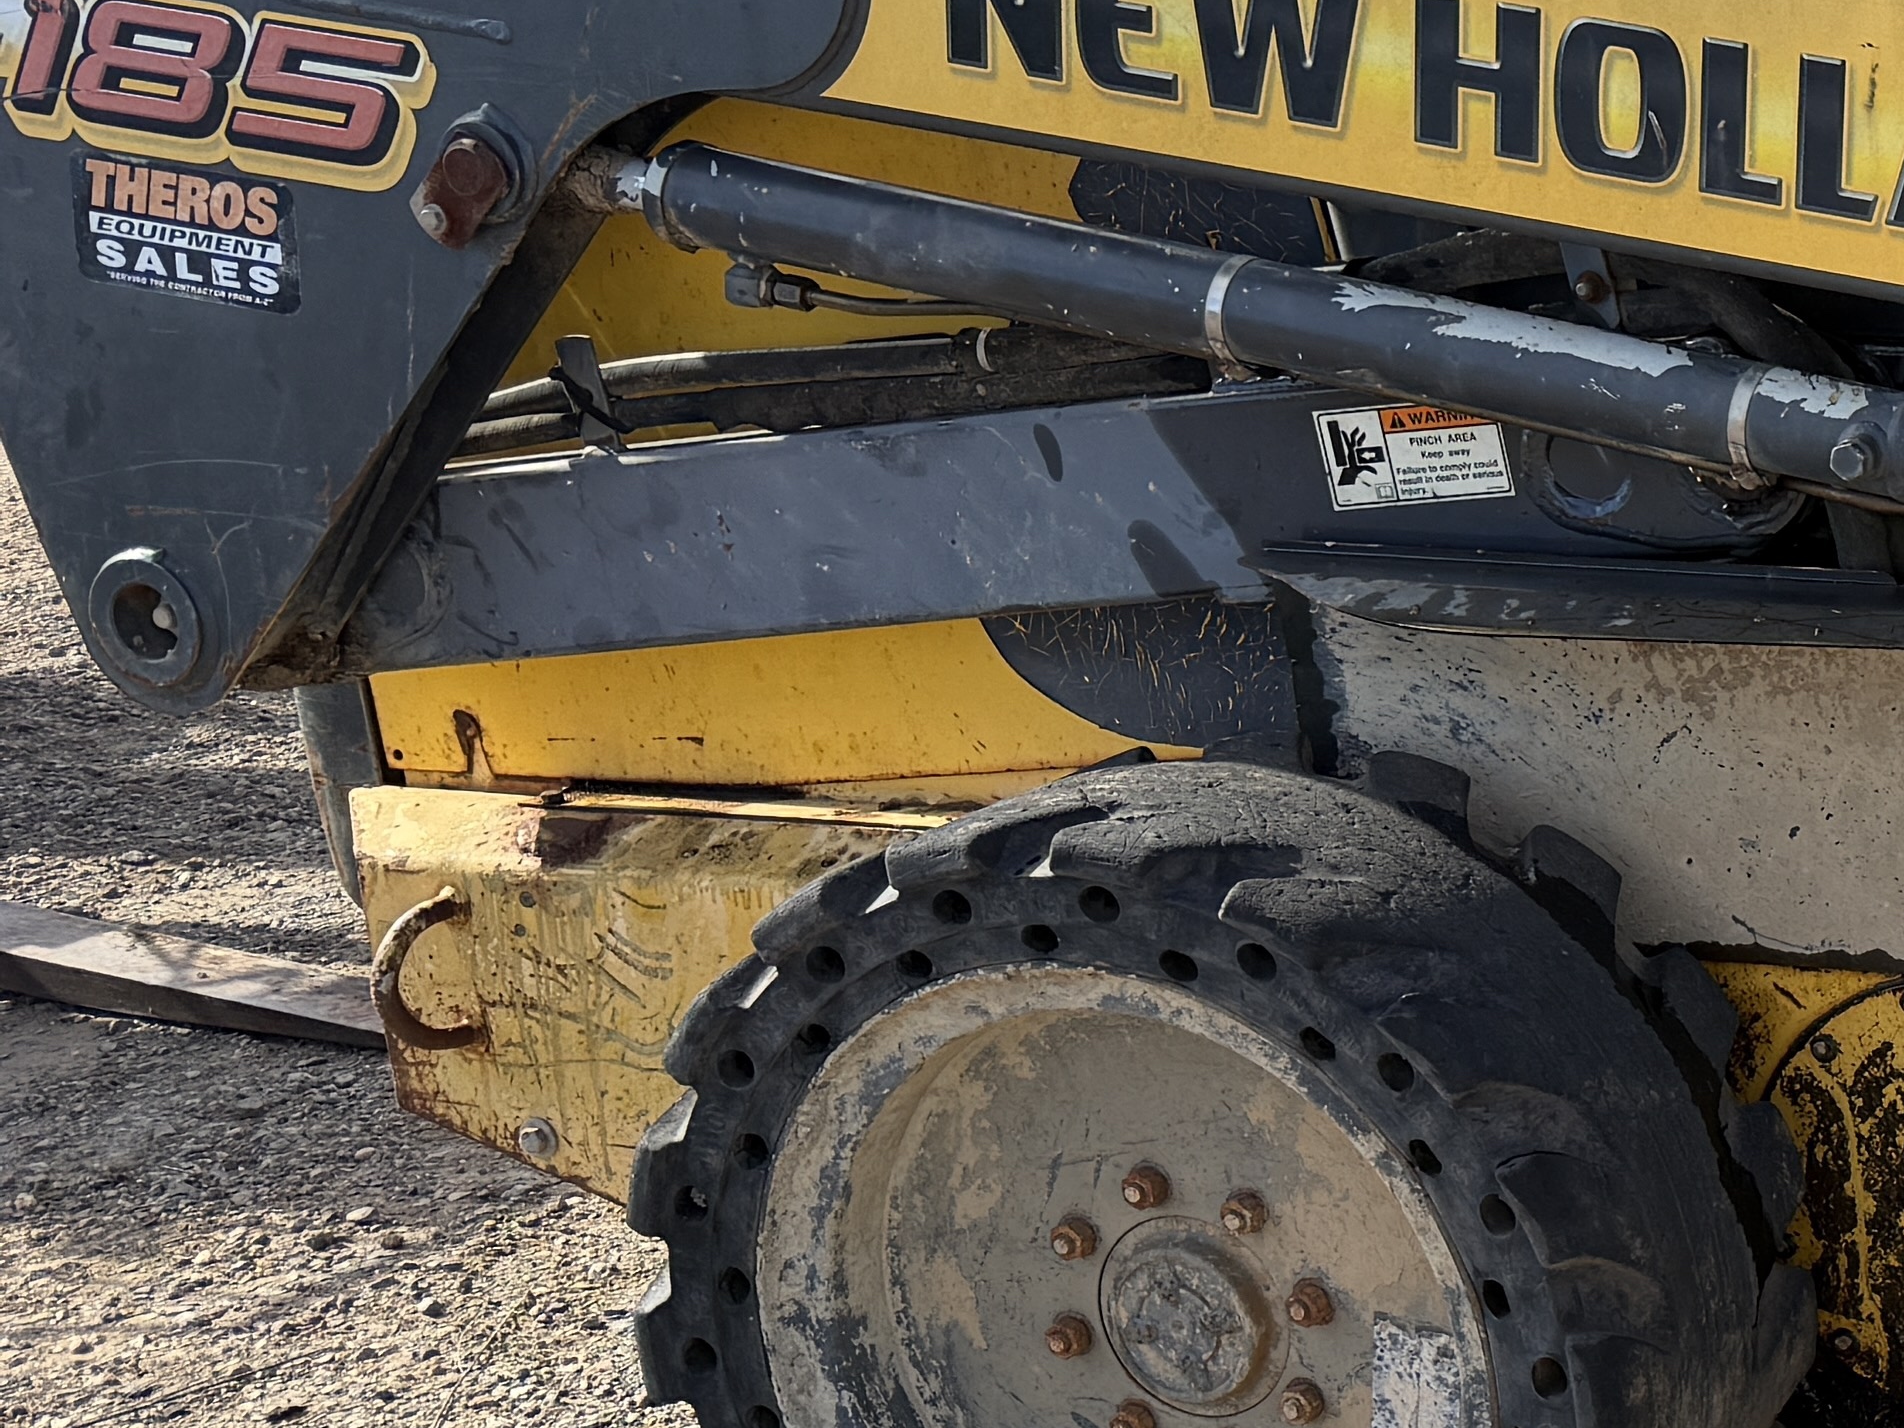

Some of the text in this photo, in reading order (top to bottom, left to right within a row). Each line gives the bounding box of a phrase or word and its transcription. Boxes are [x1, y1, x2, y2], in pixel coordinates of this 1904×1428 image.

[85, 158, 278, 236] THEROS
[97, 215, 275, 259] EQUIPMENT
[95, 238, 280, 295] SALES
[1409, 431, 1477, 447] PINCH AREA
[1396, 466, 1427, 475] Failure
[1428, 464, 1438, 473] to
[1421, 450, 1444, 460] Keep
